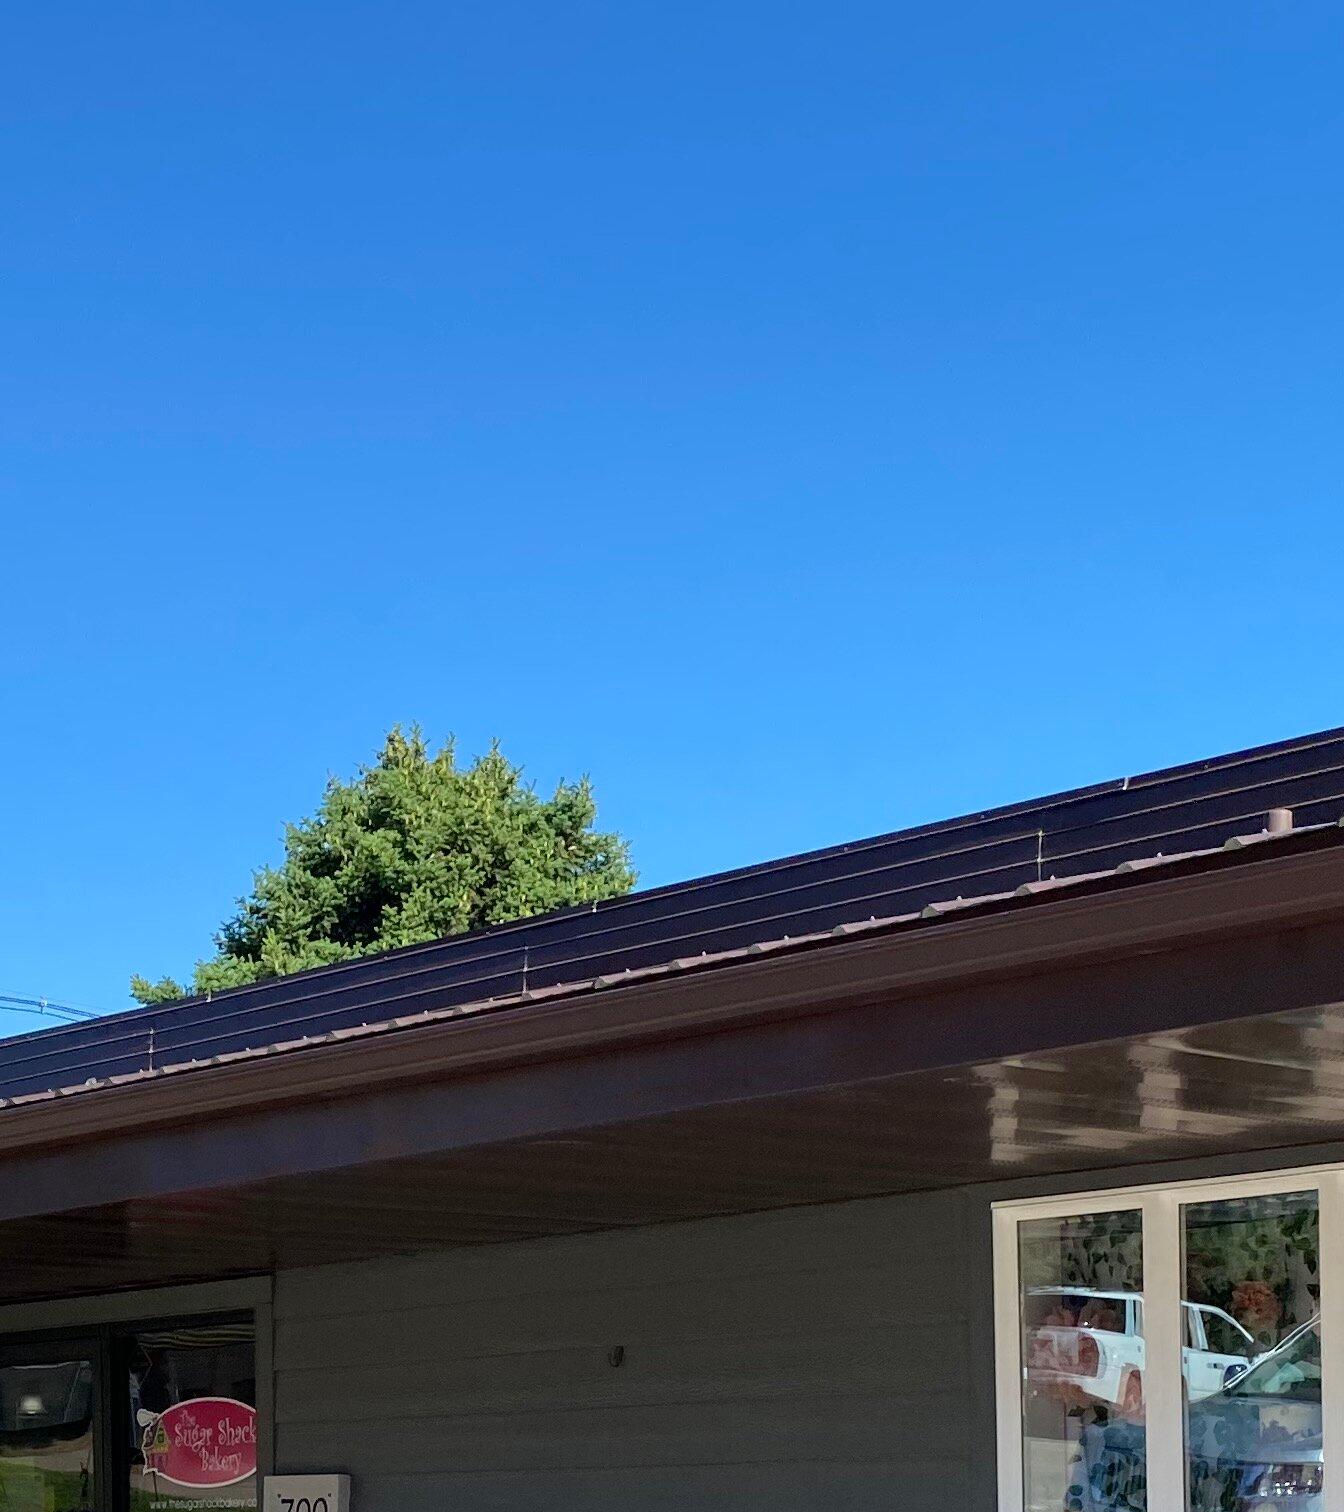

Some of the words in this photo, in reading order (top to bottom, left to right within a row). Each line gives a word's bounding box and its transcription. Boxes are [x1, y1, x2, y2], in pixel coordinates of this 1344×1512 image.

[175, 1423, 213, 1452] Sugar
[217, 1416, 257, 1447] Shack
[199, 1448, 242, 1474] Bakery
[150, 1498, 257, 1511] www.thesugarshackbakery.co
